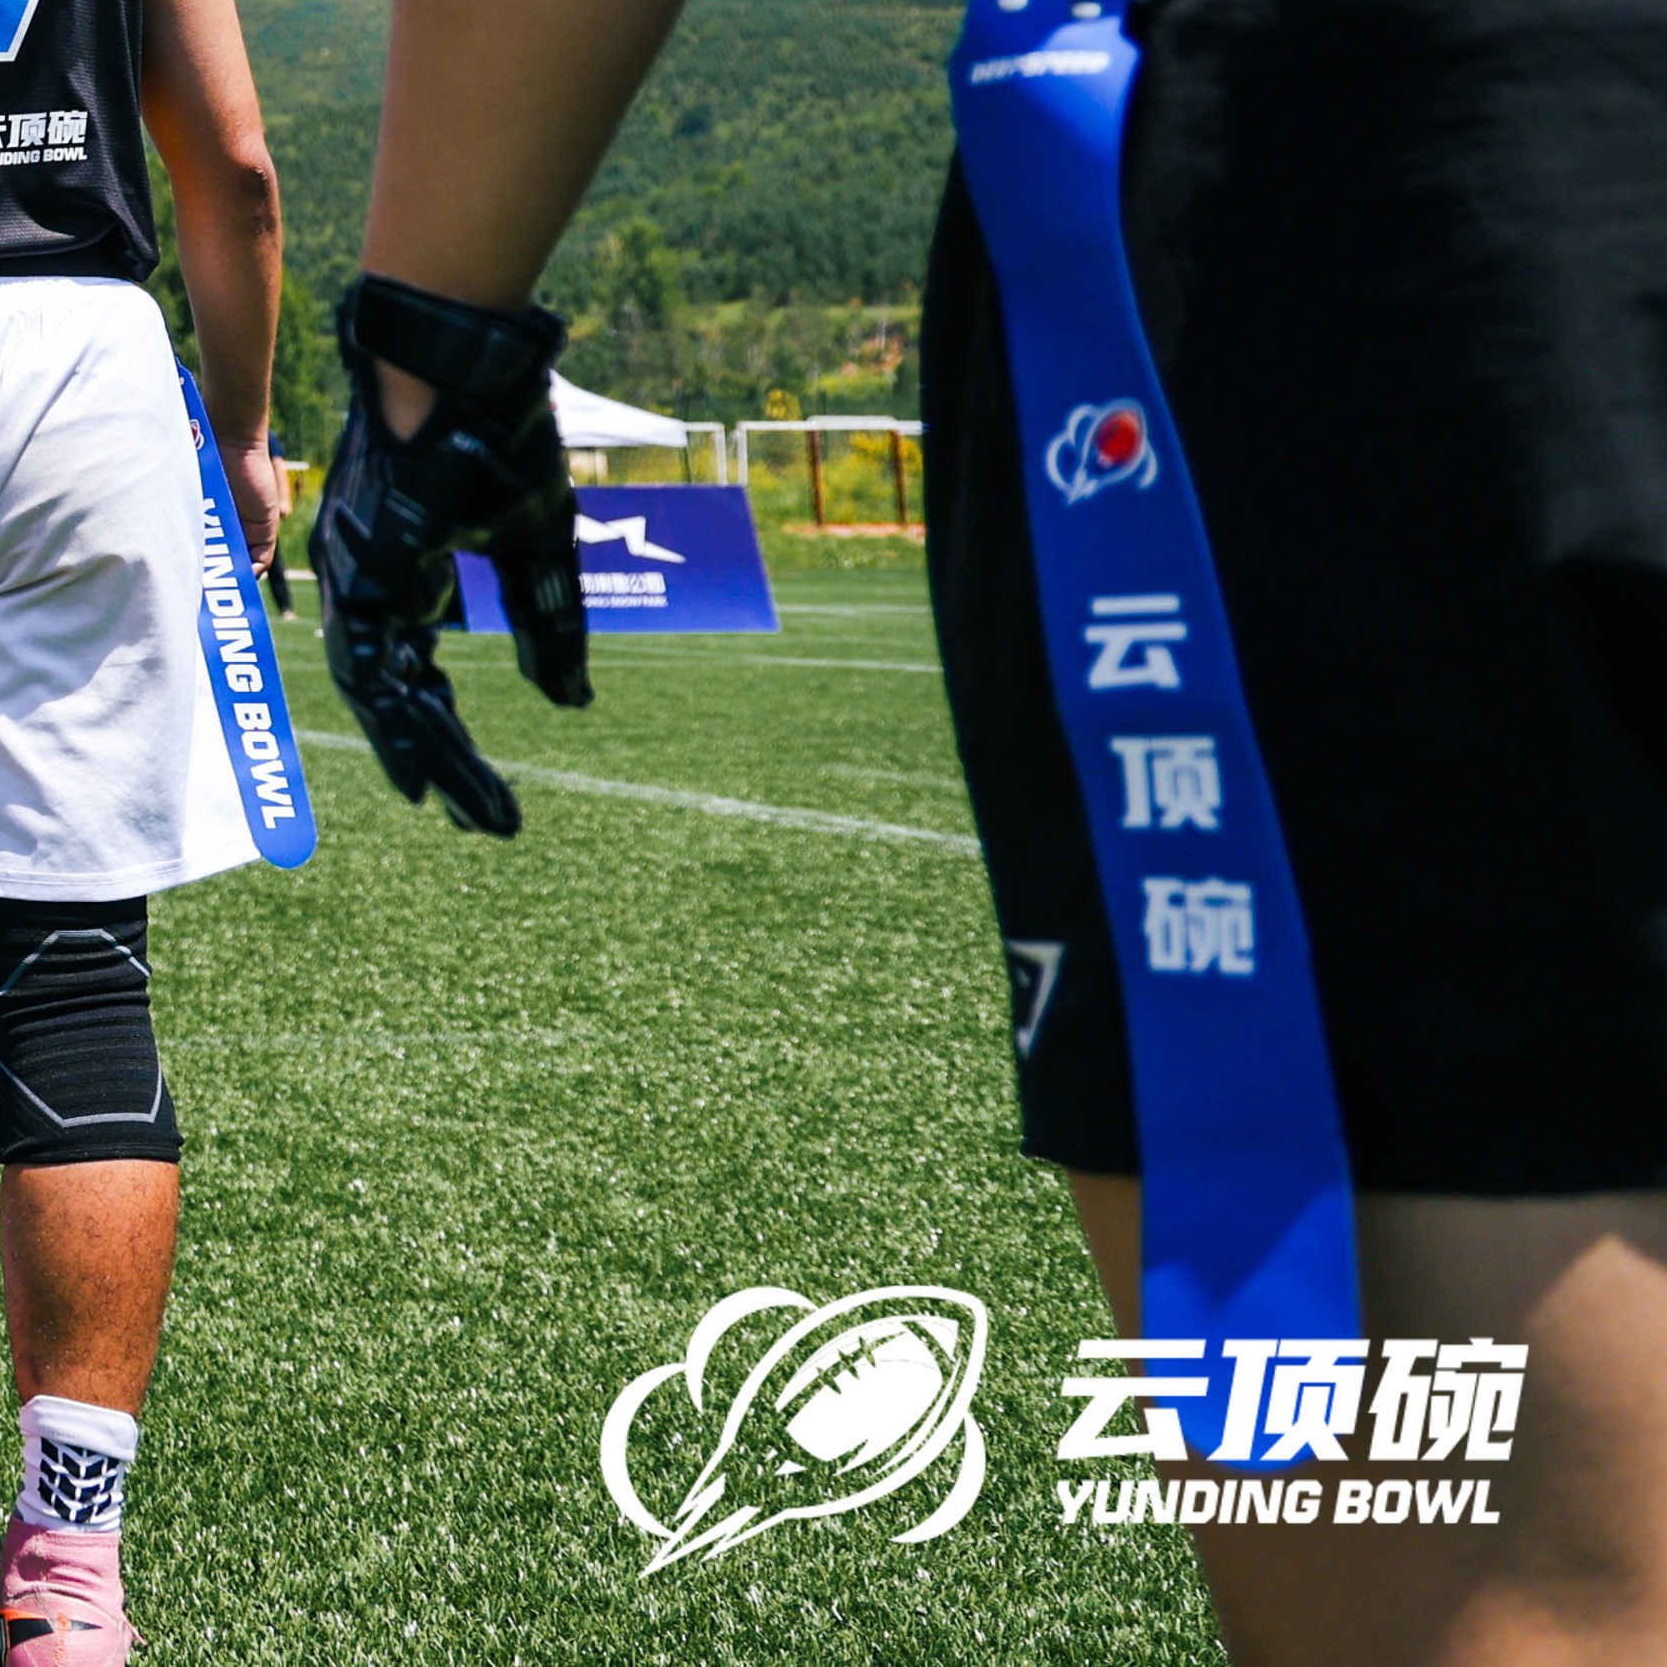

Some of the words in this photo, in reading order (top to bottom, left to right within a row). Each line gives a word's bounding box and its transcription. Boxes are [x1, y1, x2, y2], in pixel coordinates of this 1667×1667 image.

[43, 146, 88, 163] BOWL
[234, 701, 296, 830] BOWL
[1083, 592, 1255, 975] 云顶碗
